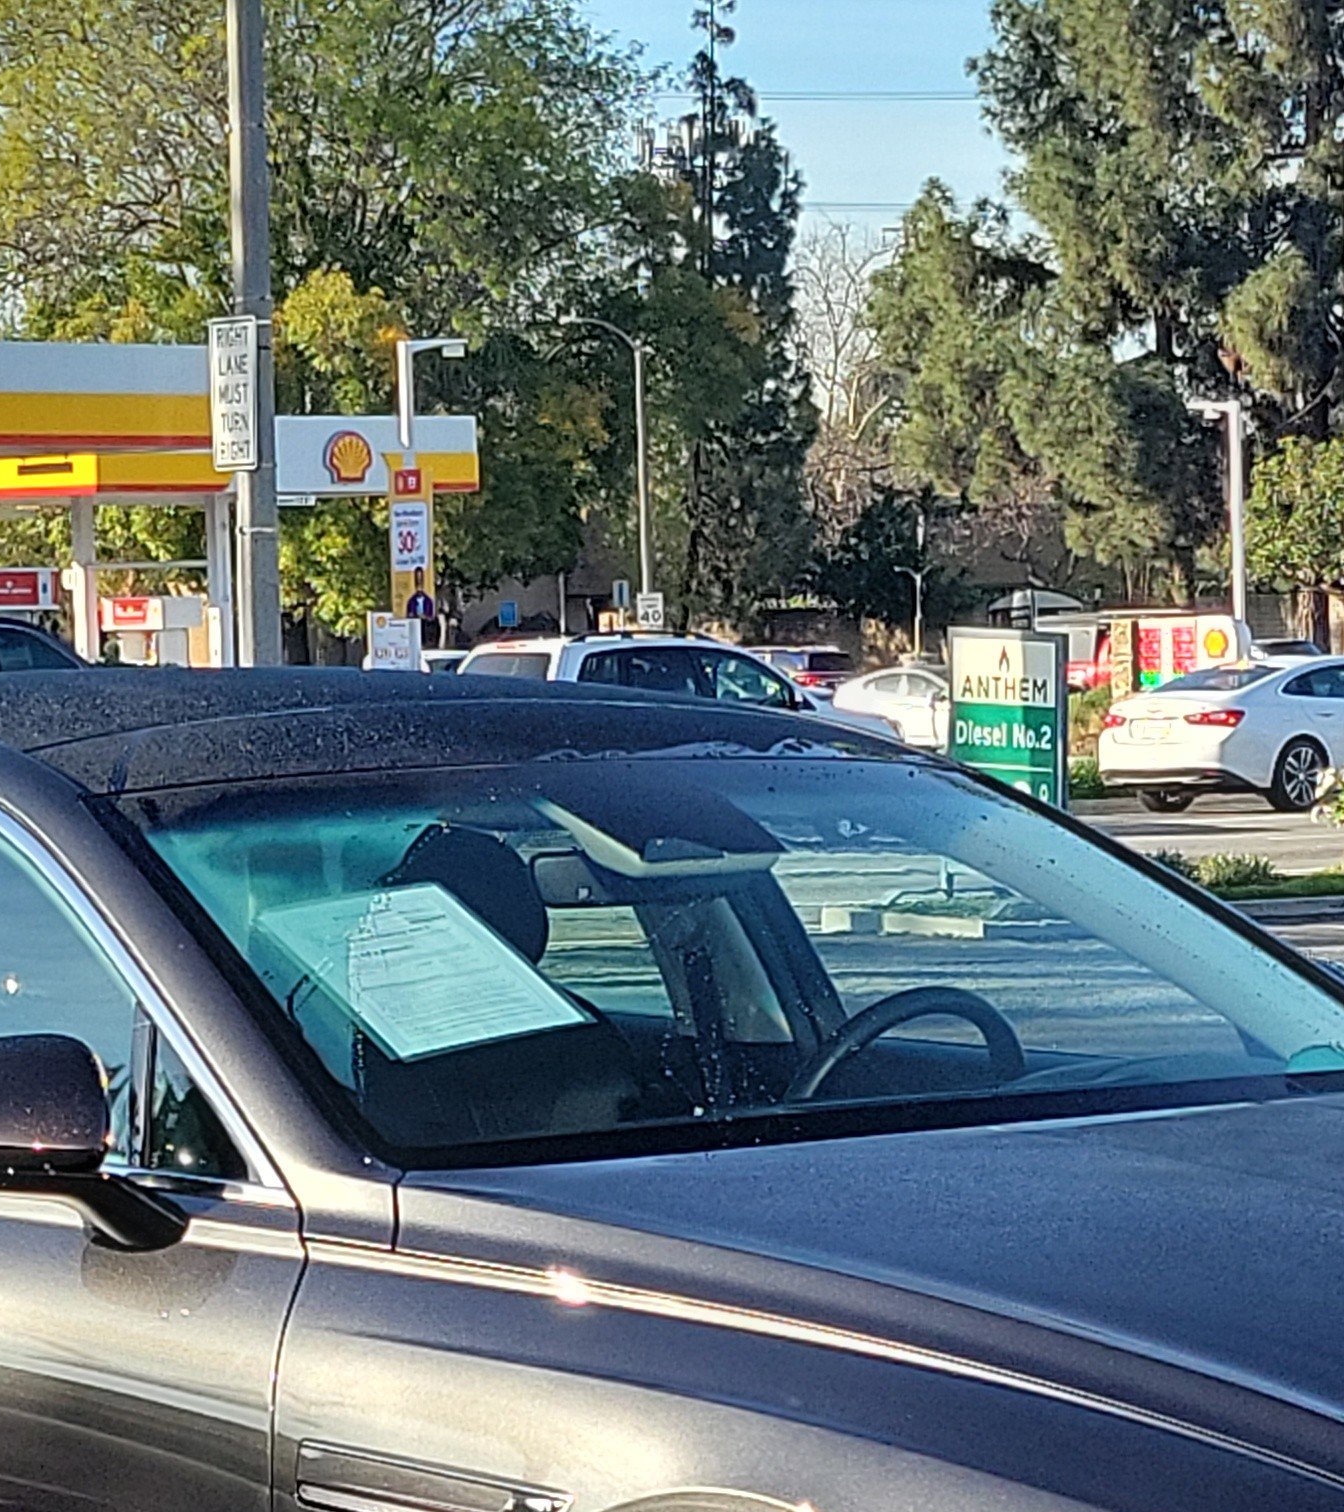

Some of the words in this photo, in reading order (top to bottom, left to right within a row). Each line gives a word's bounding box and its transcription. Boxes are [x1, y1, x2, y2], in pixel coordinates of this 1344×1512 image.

[216, 325, 249, 348] RIGHT
[218, 354, 249, 376] LANE
[218, 382, 249, 405] MUST
[220, 411, 250, 433] TURN
[220, 439, 251, 461] RIGHT
[640, 610, 662, 622] 40
[961, 675, 1048, 704] ANTHEM
[955, 719, 1008, 748] Diesel
[1012, 721, 1052, 750] No.2
